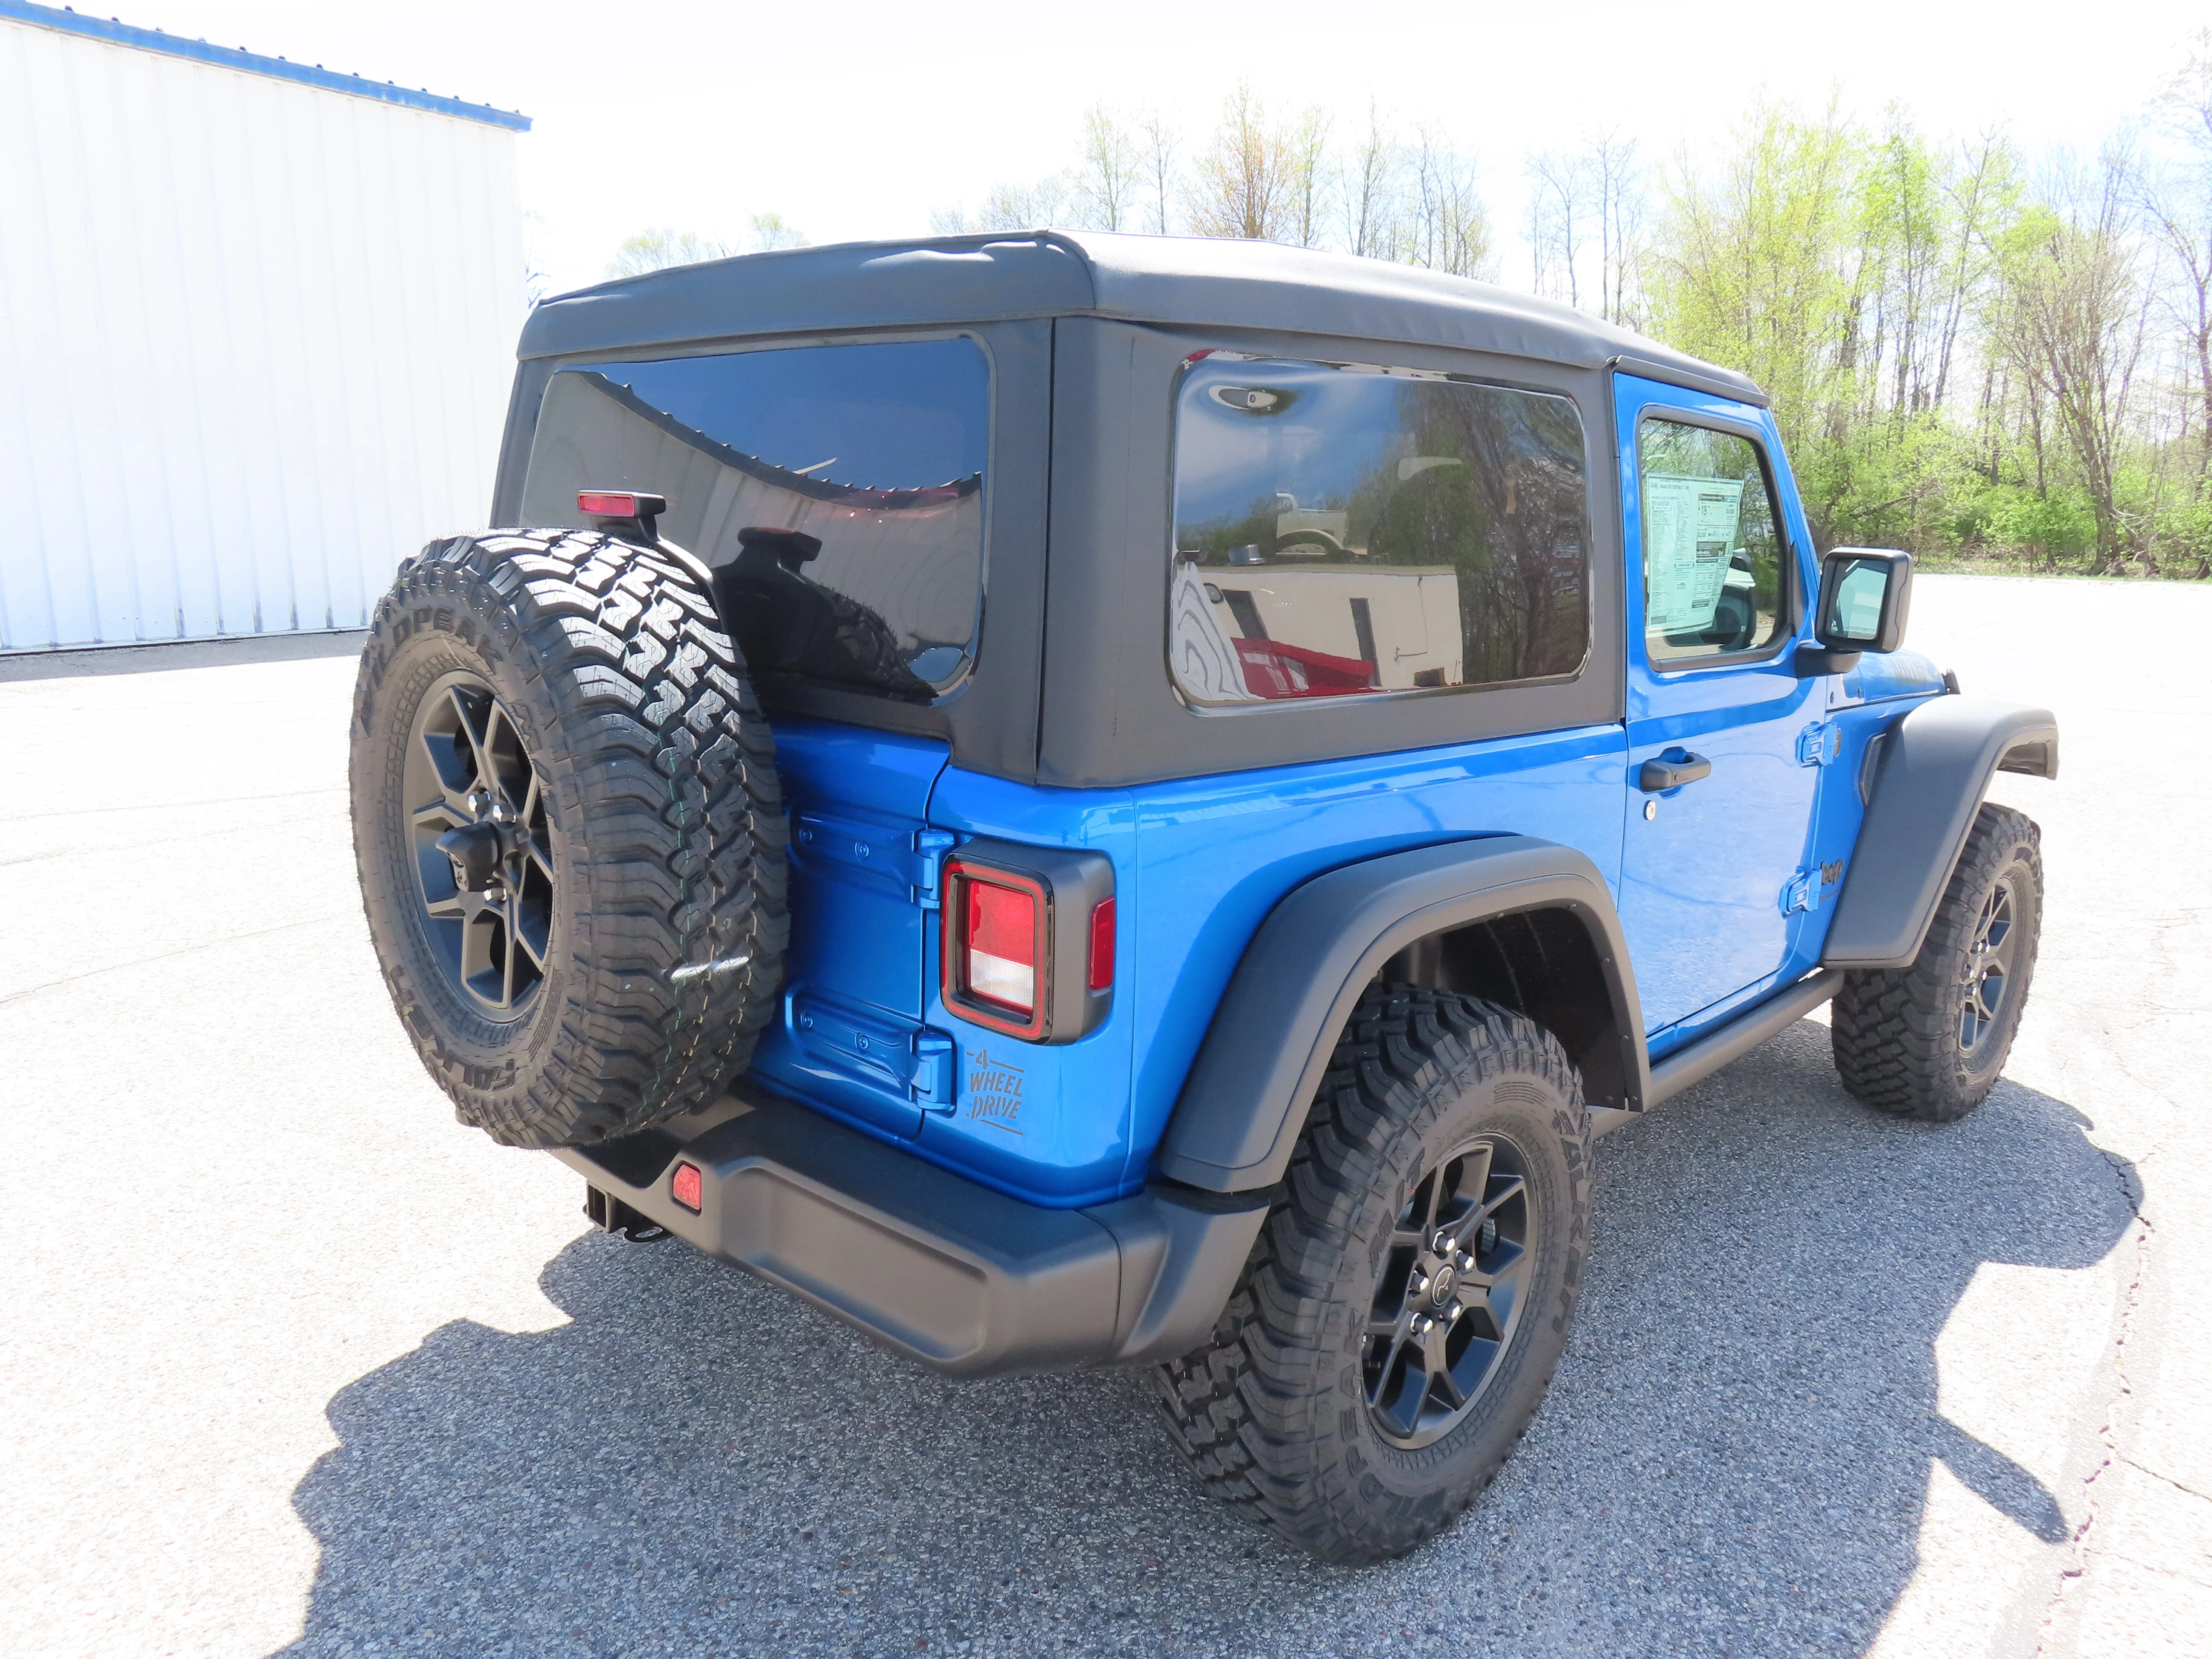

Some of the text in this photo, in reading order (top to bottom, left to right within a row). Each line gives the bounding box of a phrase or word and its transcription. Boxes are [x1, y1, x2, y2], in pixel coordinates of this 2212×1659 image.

[975, 1049, 989, 1069] 4
[970, 1071, 1023, 1097] WHEEL
[971, 1095, 1022, 1119] DRIVE
